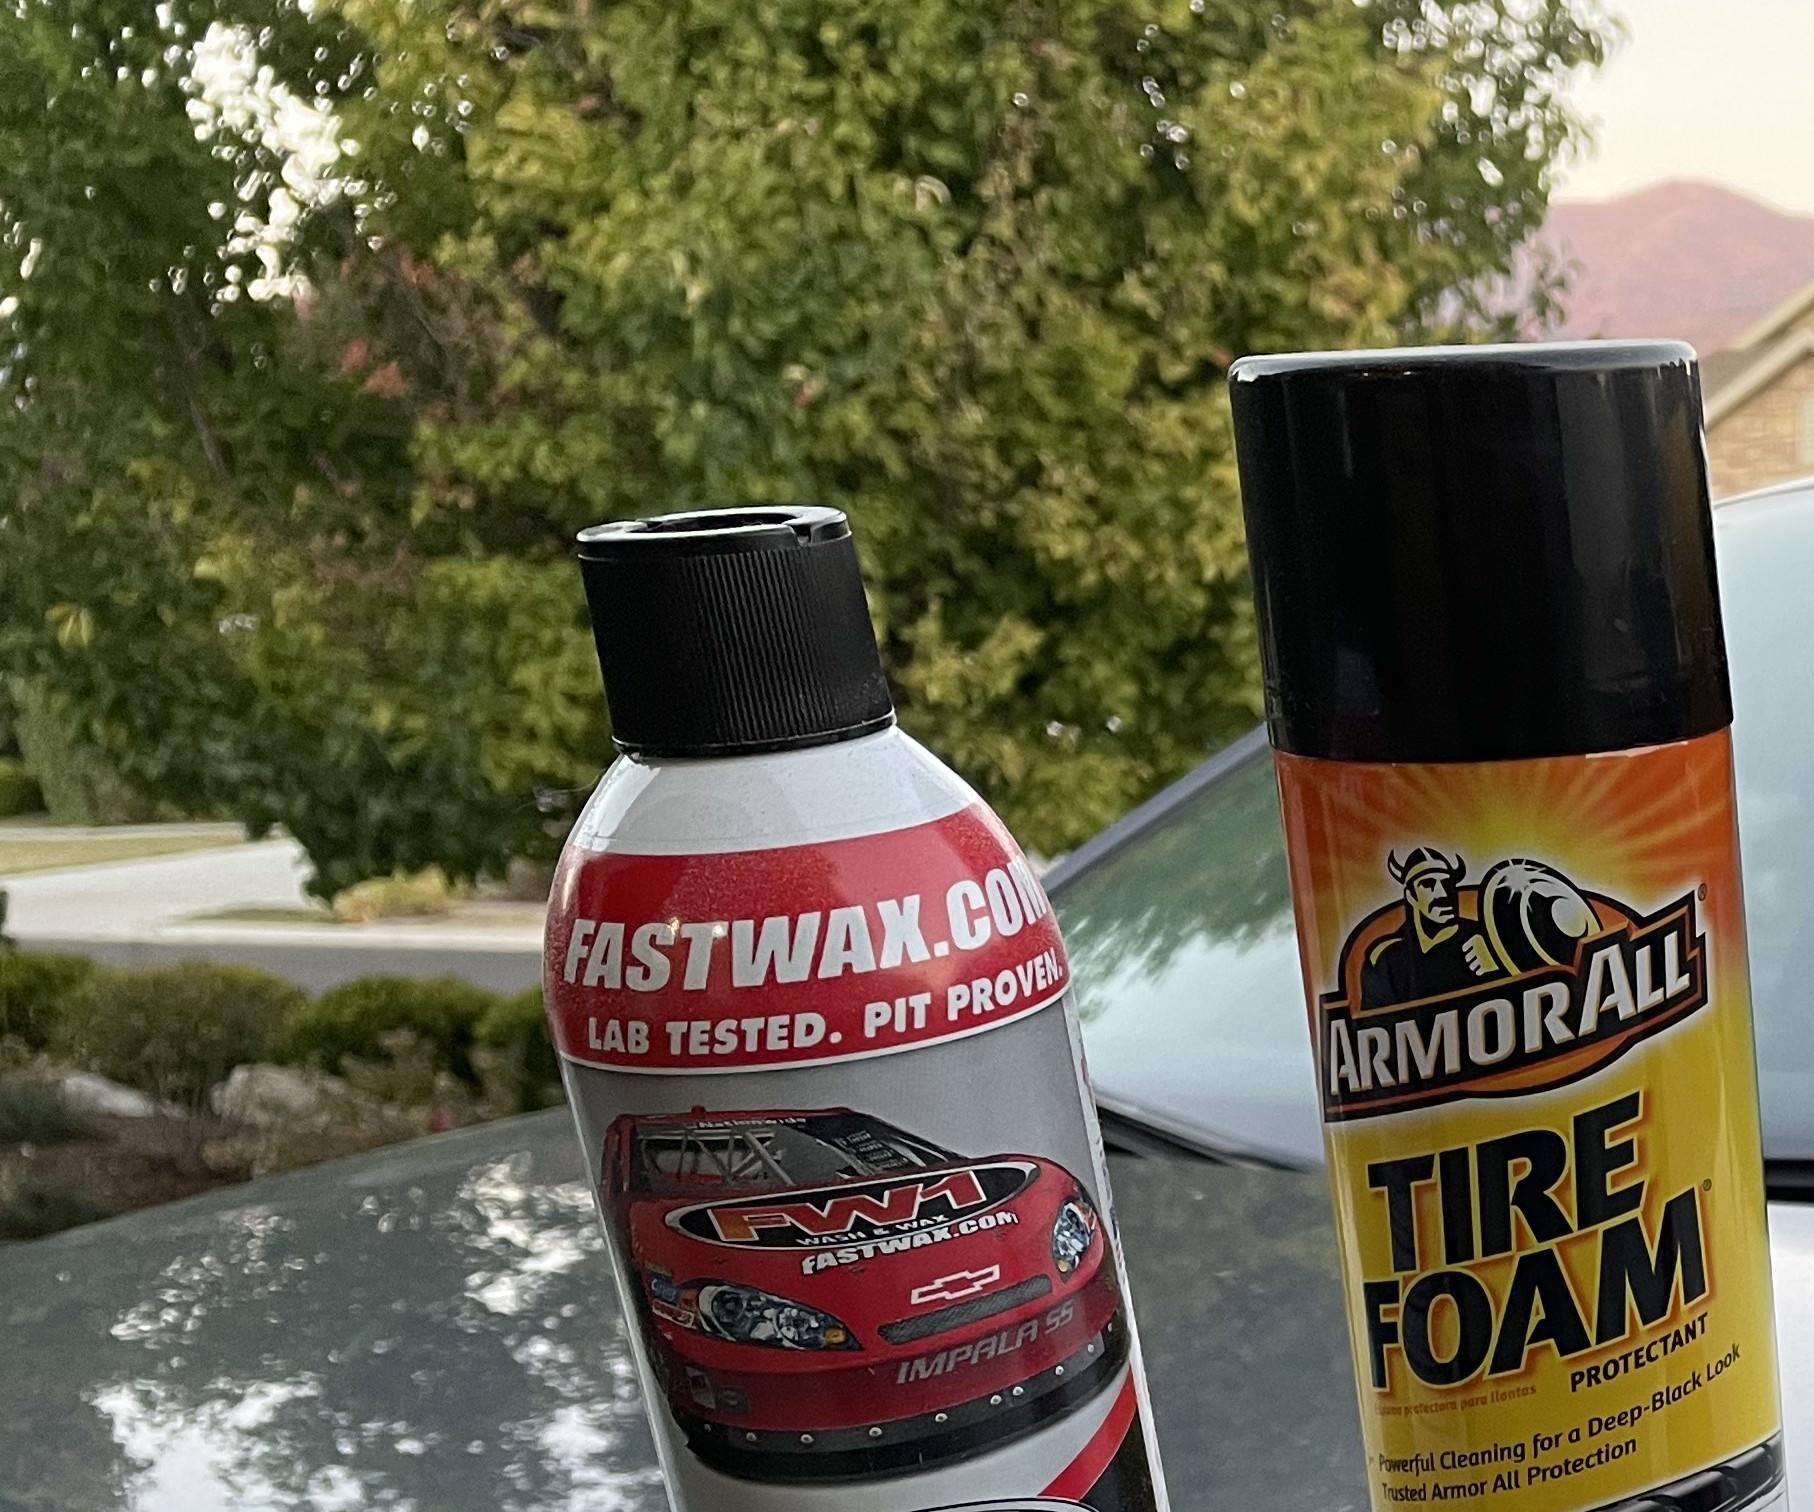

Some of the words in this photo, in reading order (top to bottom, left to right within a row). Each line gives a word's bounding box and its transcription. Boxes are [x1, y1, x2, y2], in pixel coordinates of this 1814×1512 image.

[563, 857, 1047, 992] FASTWAX.COM
[588, 1016, 650, 1055] LAB
[665, 1013, 843, 1056] TESTED.
[864, 992, 933, 1038] PIT
[946, 946, 1063, 1021] PROVEN.
[706, 1168, 988, 1242] FW1
[1368, 1088, 1646, 1275] TIRE
[796, 1230, 864, 1246] WASH
[873, 1225, 890, 1236] &
[895, 1214, 951, 1232] WAX
[801, 1210, 1020, 1276] FASTWAX.COM
[1363, 1187, 1707, 1390] FOAM
[896, 1319, 1039, 1384] IMPALA
[1044, 1300, 1074, 1335] SS
[1570, 1312, 1709, 1394] PROTECTANT
[1379, 1452, 1436, 1476] Powerful
[1439, 1443, 1526, 1470] Cleaning
[1532, 1431, 1562, 1459] for
[1568, 1427, 1581, 1443] a
[1588, 1368, 1702, 1438] Deep-Black
[1705, 1341, 1742, 1382] Look
[1460, 1395, 1487, 1412] para
[1382, 1482, 1427, 1502] Trusted
[1431, 1480, 1488, 1501] Armor
[1492, 1469, 1521, 1493] All
[1526, 1436, 1638, 1486] Protection
